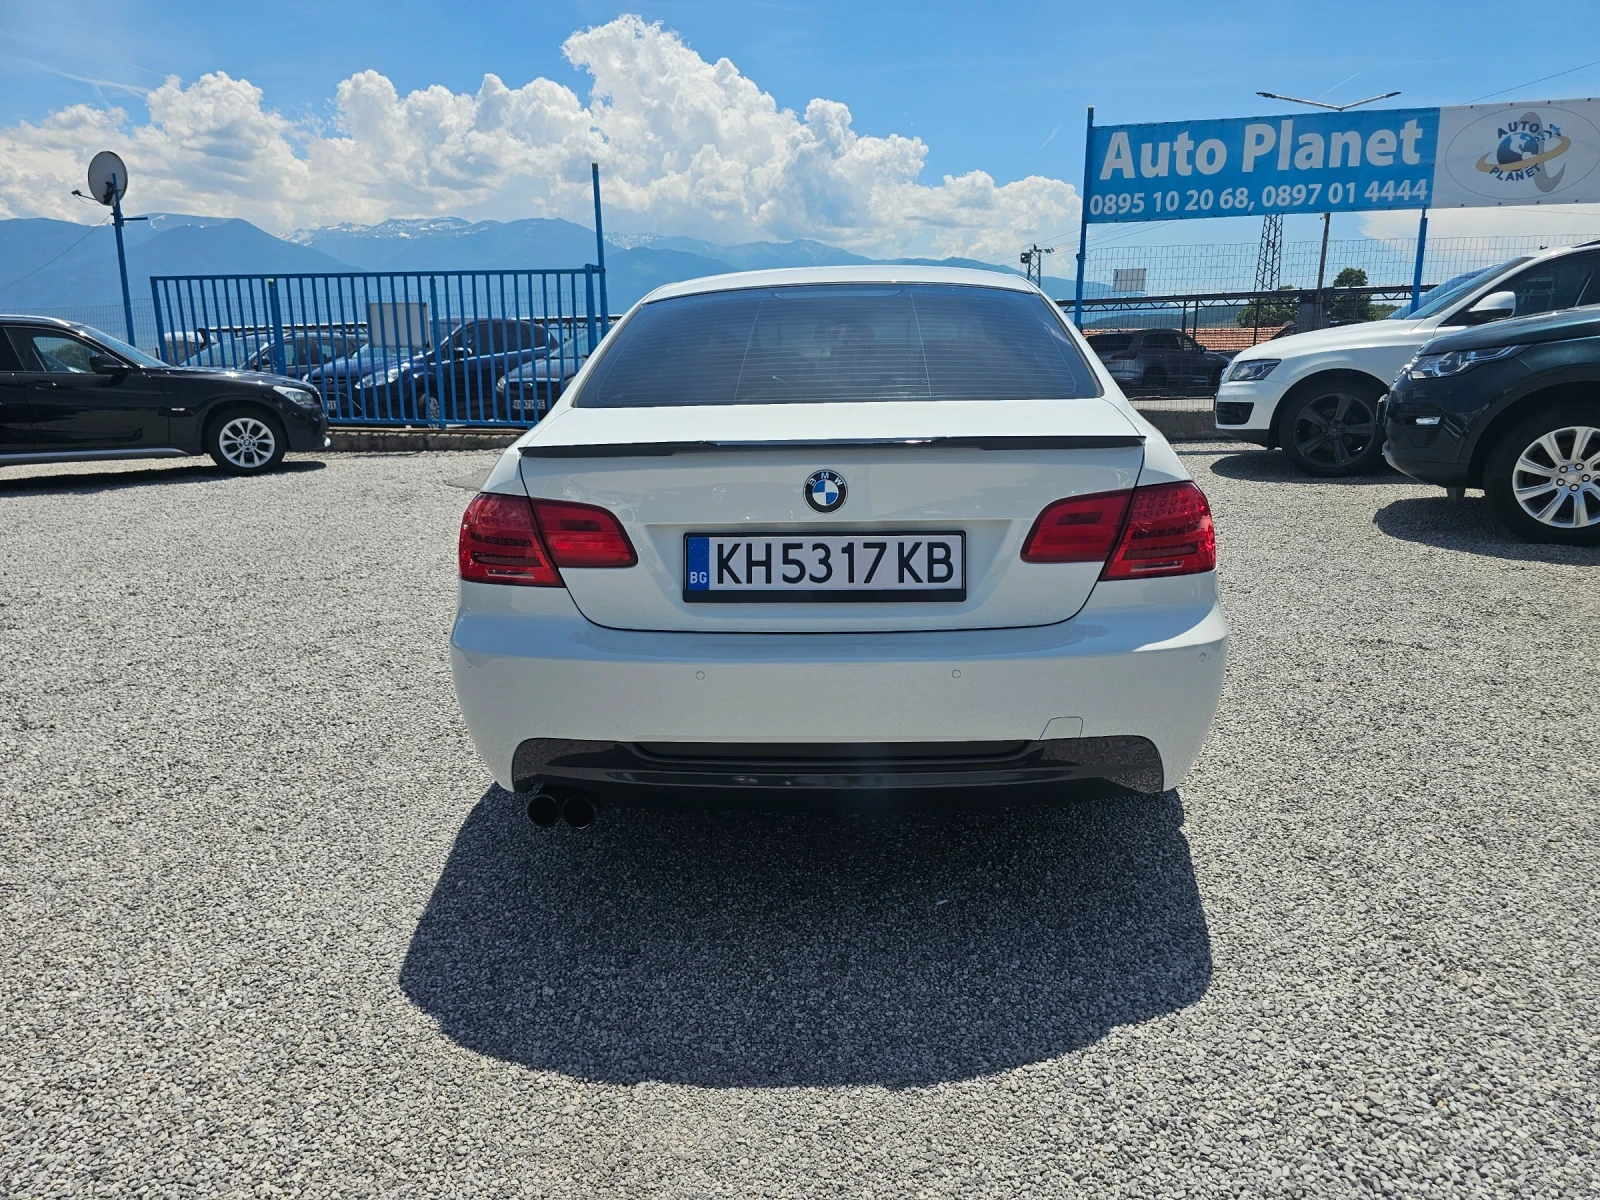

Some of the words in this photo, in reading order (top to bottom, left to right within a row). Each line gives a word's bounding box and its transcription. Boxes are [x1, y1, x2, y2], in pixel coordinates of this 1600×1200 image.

[1497, 120, 1540, 139] AUTO
[1099, 131, 1227, 180] Auto
[1241, 118, 1423, 173] Planet
[1489, 163, 1541, 182] PLANET
[1089, 192, 1145, 216] 0895
[1153, 190, 1180, 212] 10
[1184, 188, 1214, 211] 20
[1219, 187, 1255, 211] 68,
[1261, 183, 1322, 207] 0897
[1327, 181, 1356, 204] 01
[1364, 178, 1428, 203] 4444
[808, 471, 843, 486] BMW
[717, 543, 772, 585] KH
[781, 542, 887, 584] 5317
[897, 541, 954, 584] KB
[690, 571, 708, 585] BG
